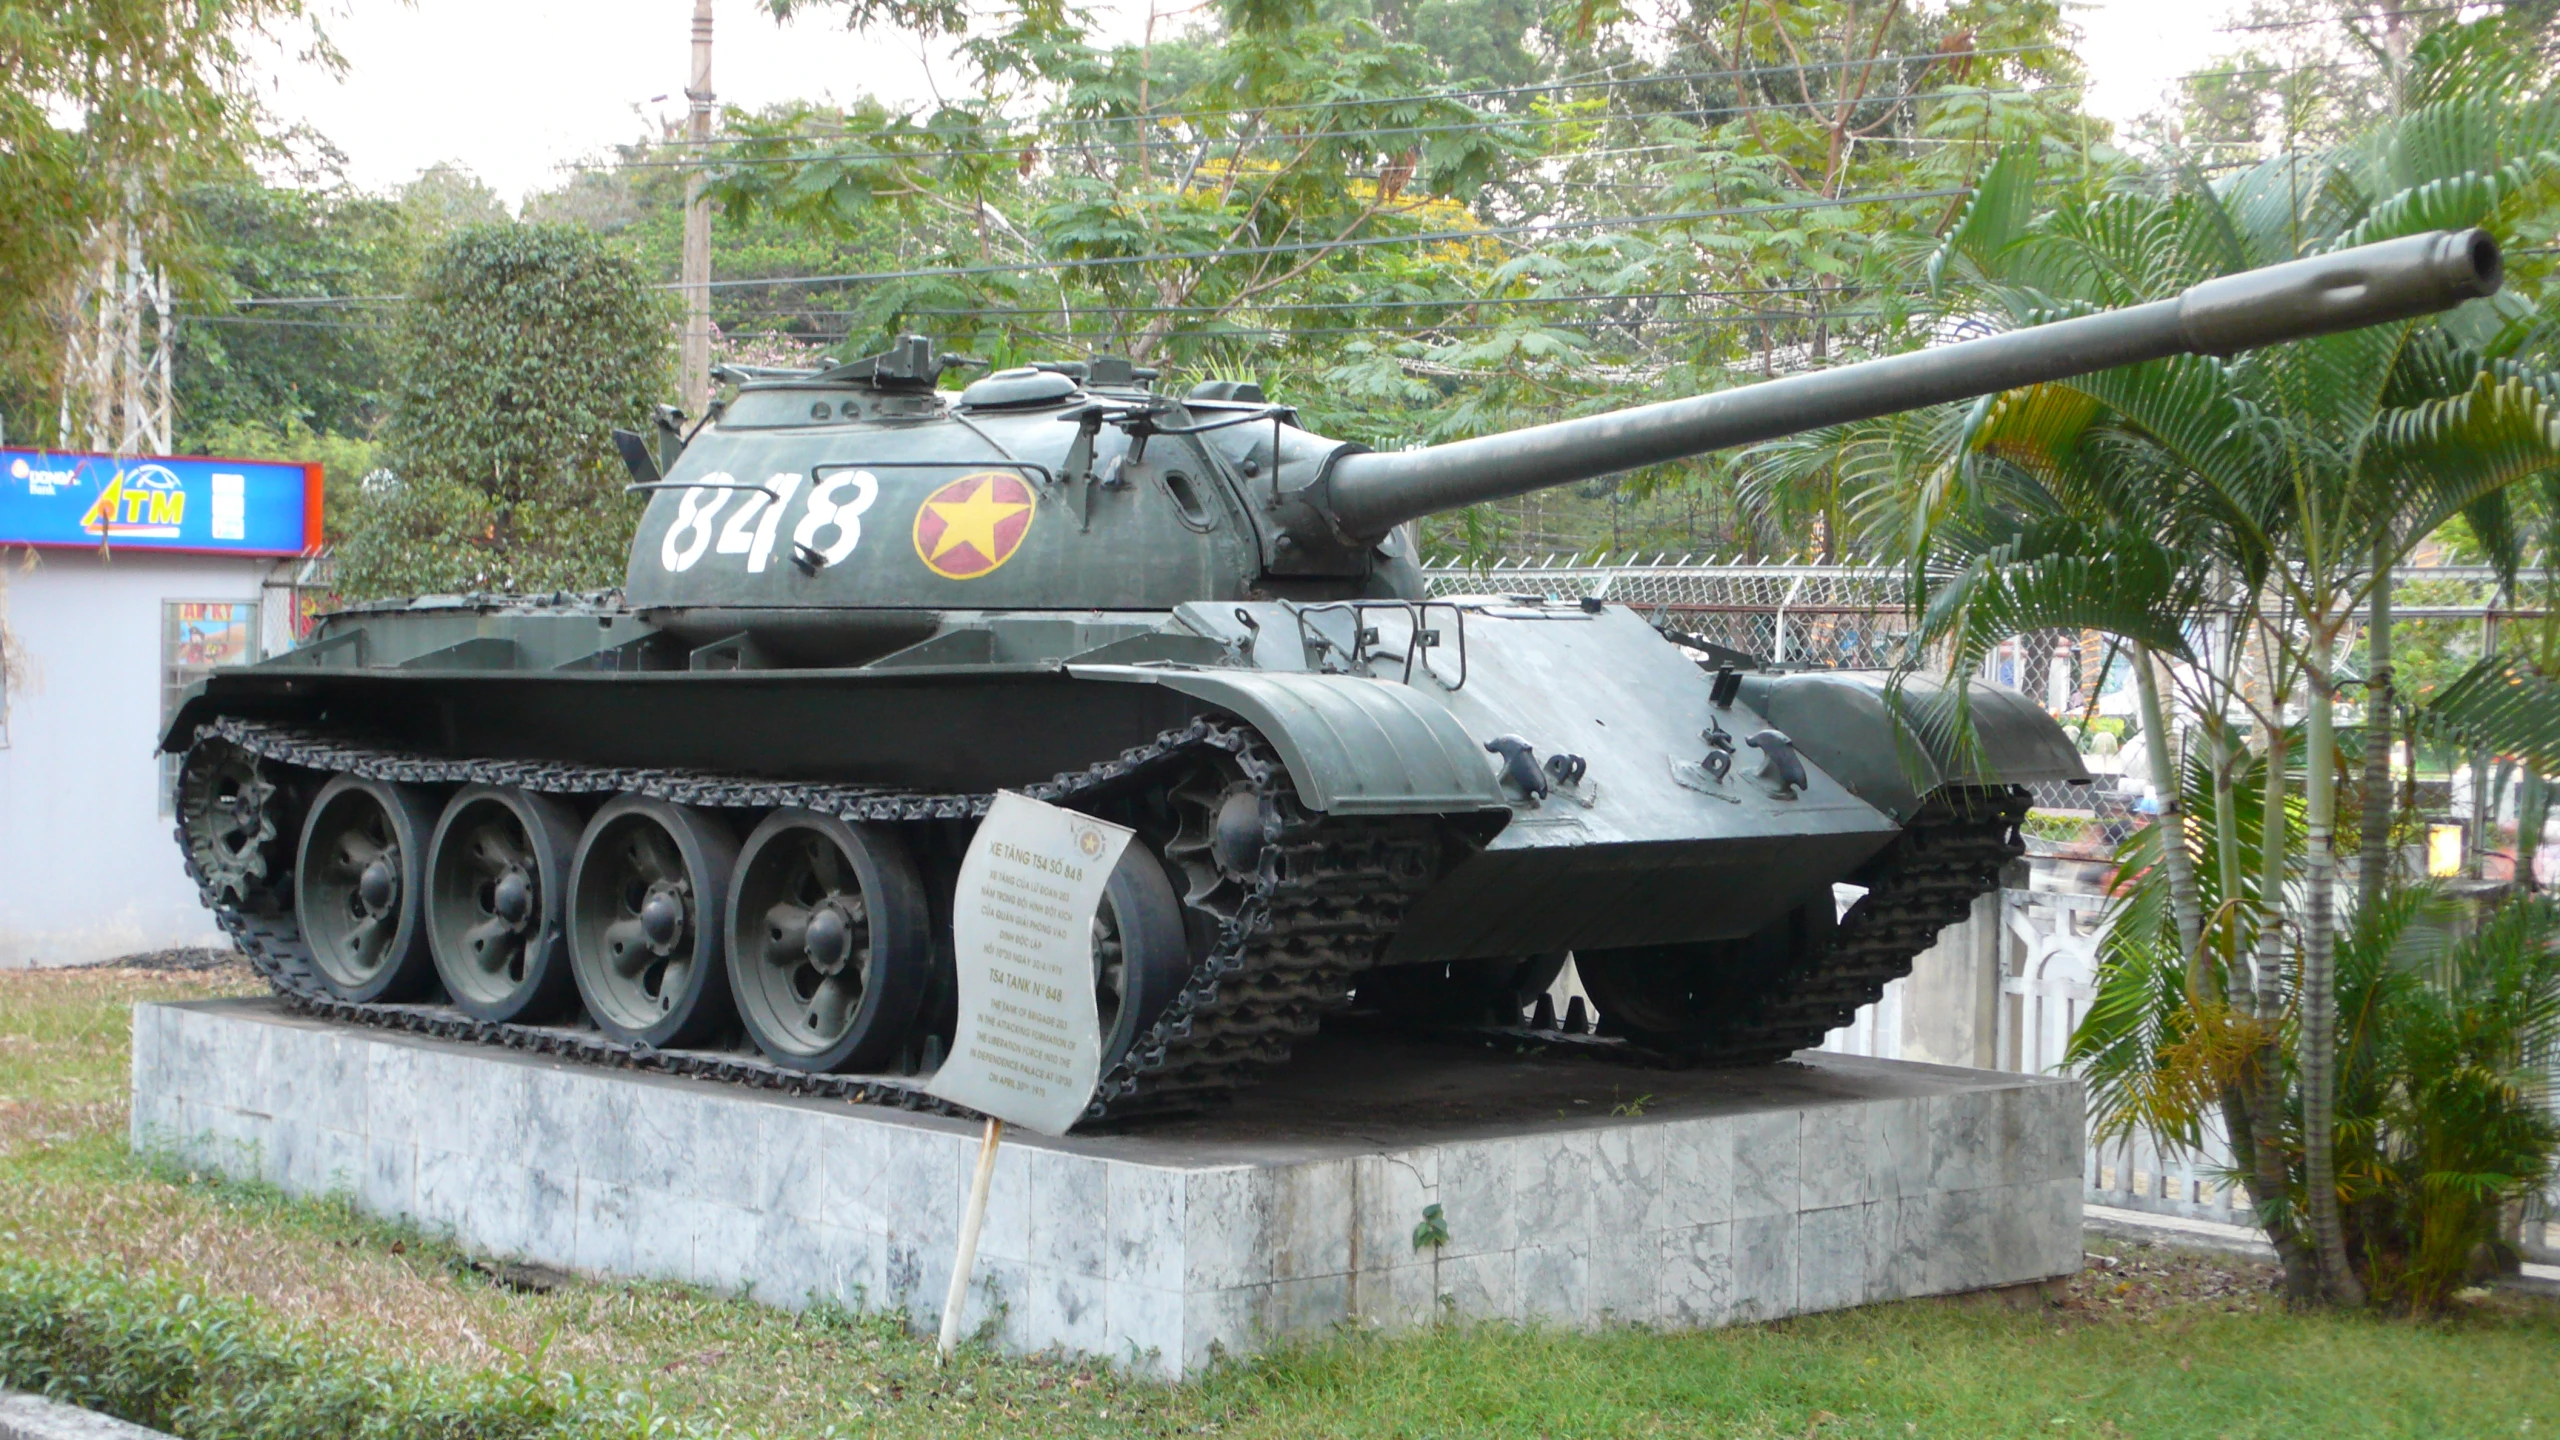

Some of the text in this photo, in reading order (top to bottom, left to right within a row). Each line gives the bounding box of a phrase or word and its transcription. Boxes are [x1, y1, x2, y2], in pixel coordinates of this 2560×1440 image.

[80, 469, 186, 527] ATM
[661, 470, 878, 573] 848
[989, 840, 1002, 857] XE
[1033, 853, 1048, 871] T54
[996, 890, 1016, 905] TRONG
[989, 968, 1004, 985] T54
[1006, 973, 1031, 994] TANK
[990, 998, 1001, 1010] THE
[1002, 1000, 1017, 1015] TANK
[1018, 1007, 1027, 1017] OF
[1027, 1008, 1056, 1027] BRIGADE
[977, 1013, 1077, 1051] IN THE ATTACKING FORMATION OF
[976, 1030, 1072, 1069] THE LIBERATION FORCE INTO THE
[988, 1072, 999, 1083] ON
[999, 1075, 1016, 1090] APRIL
[1019, 1061, 1045, 1080] PALACE
[1045, 1071, 1055, 1082] AT
